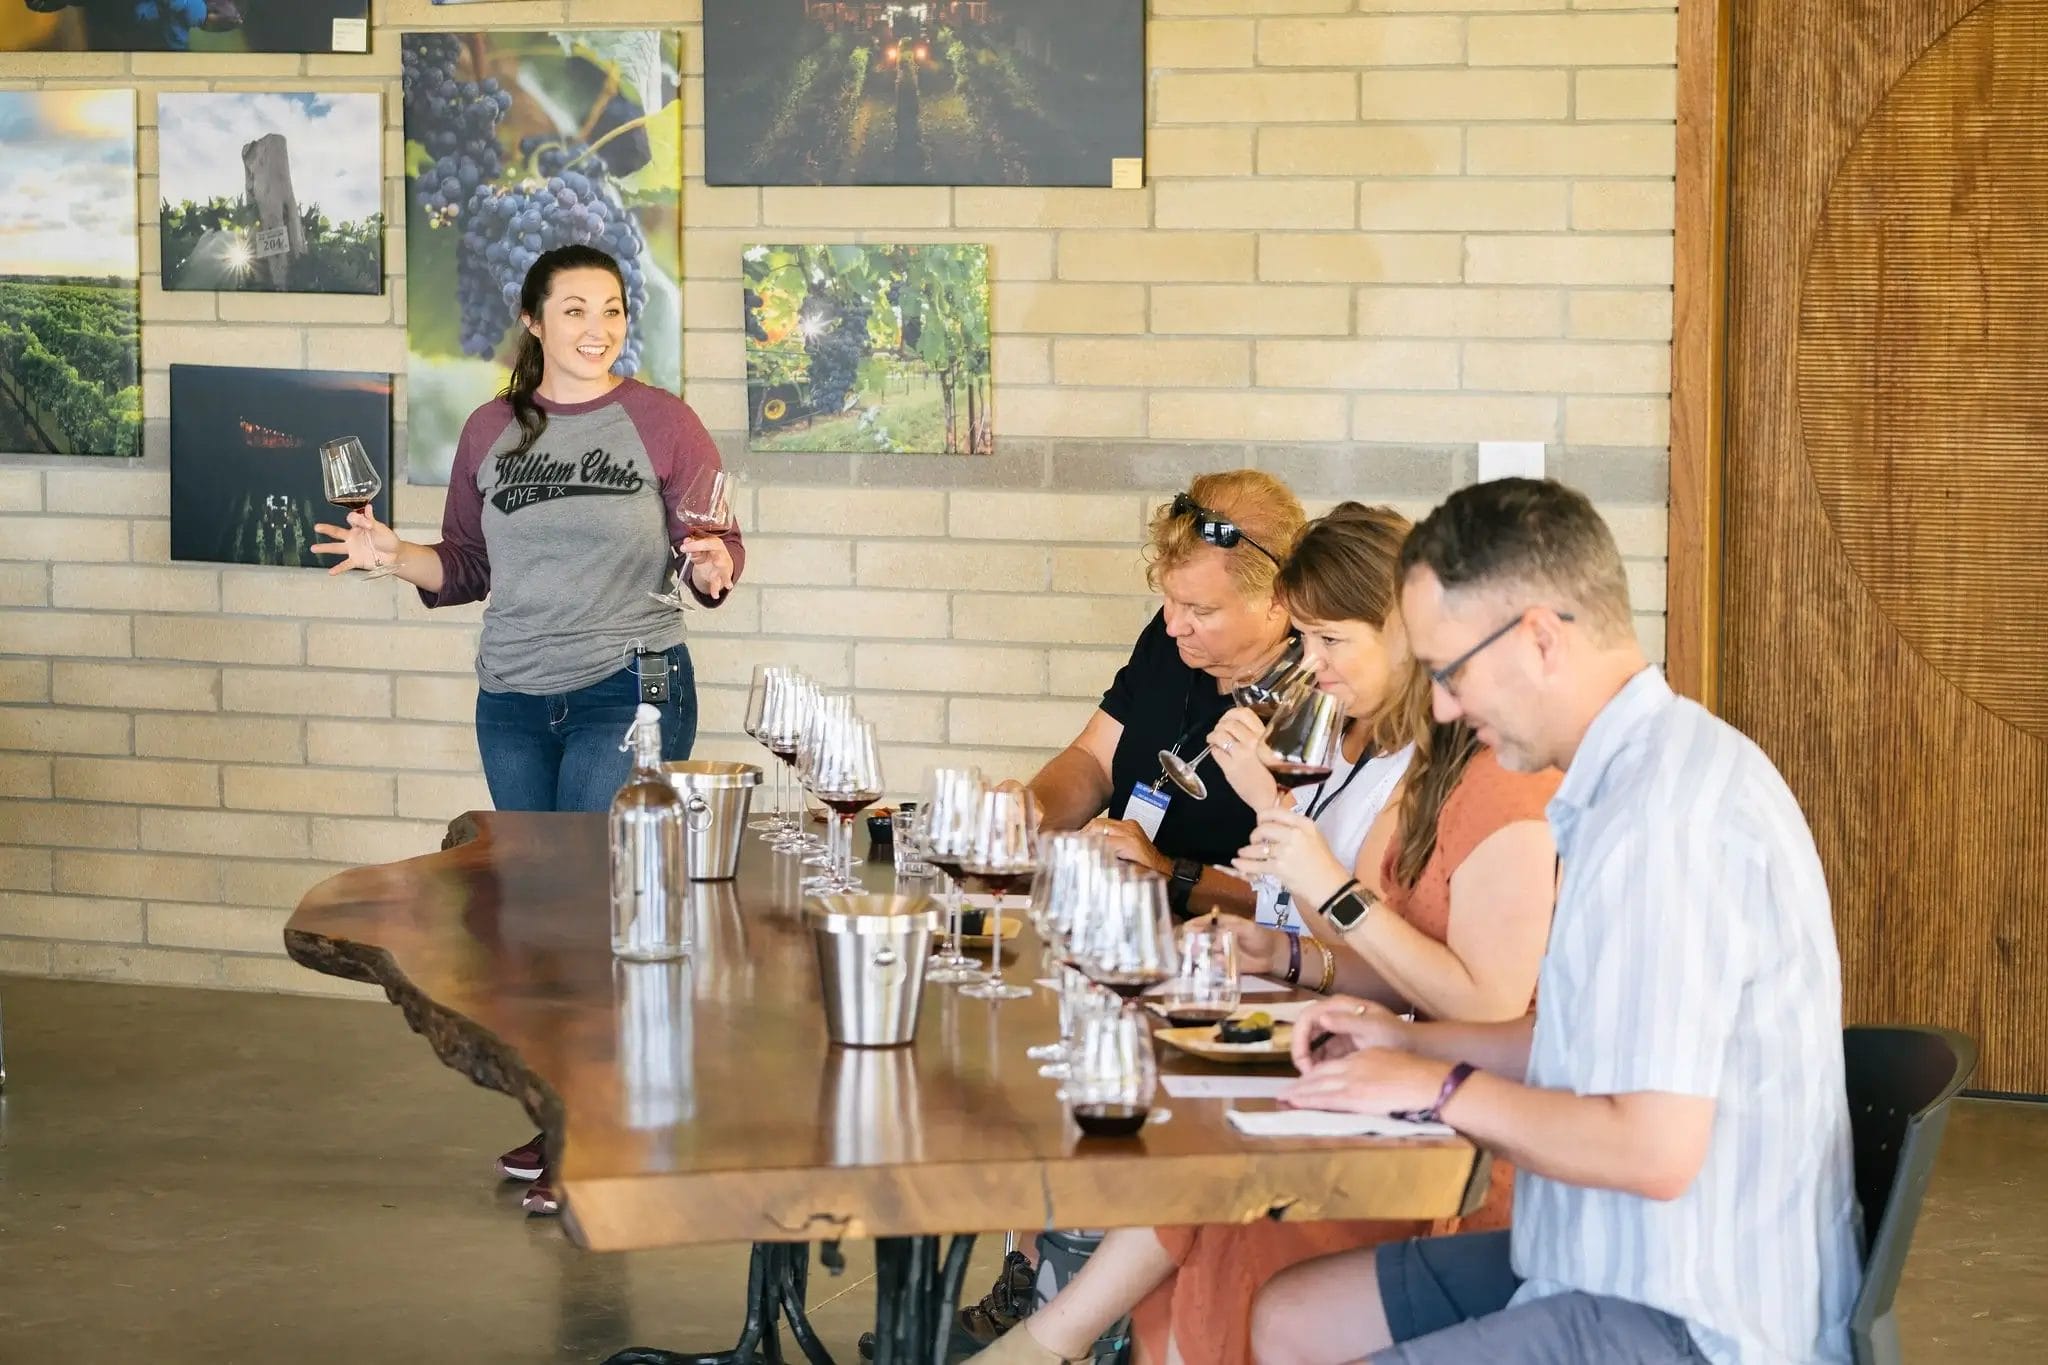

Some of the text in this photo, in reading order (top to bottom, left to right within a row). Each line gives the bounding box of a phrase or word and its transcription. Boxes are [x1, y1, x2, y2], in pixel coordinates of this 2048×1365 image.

[495, 448, 643, 490] William Chris
[505, 486, 567, 510] HYE, TX
